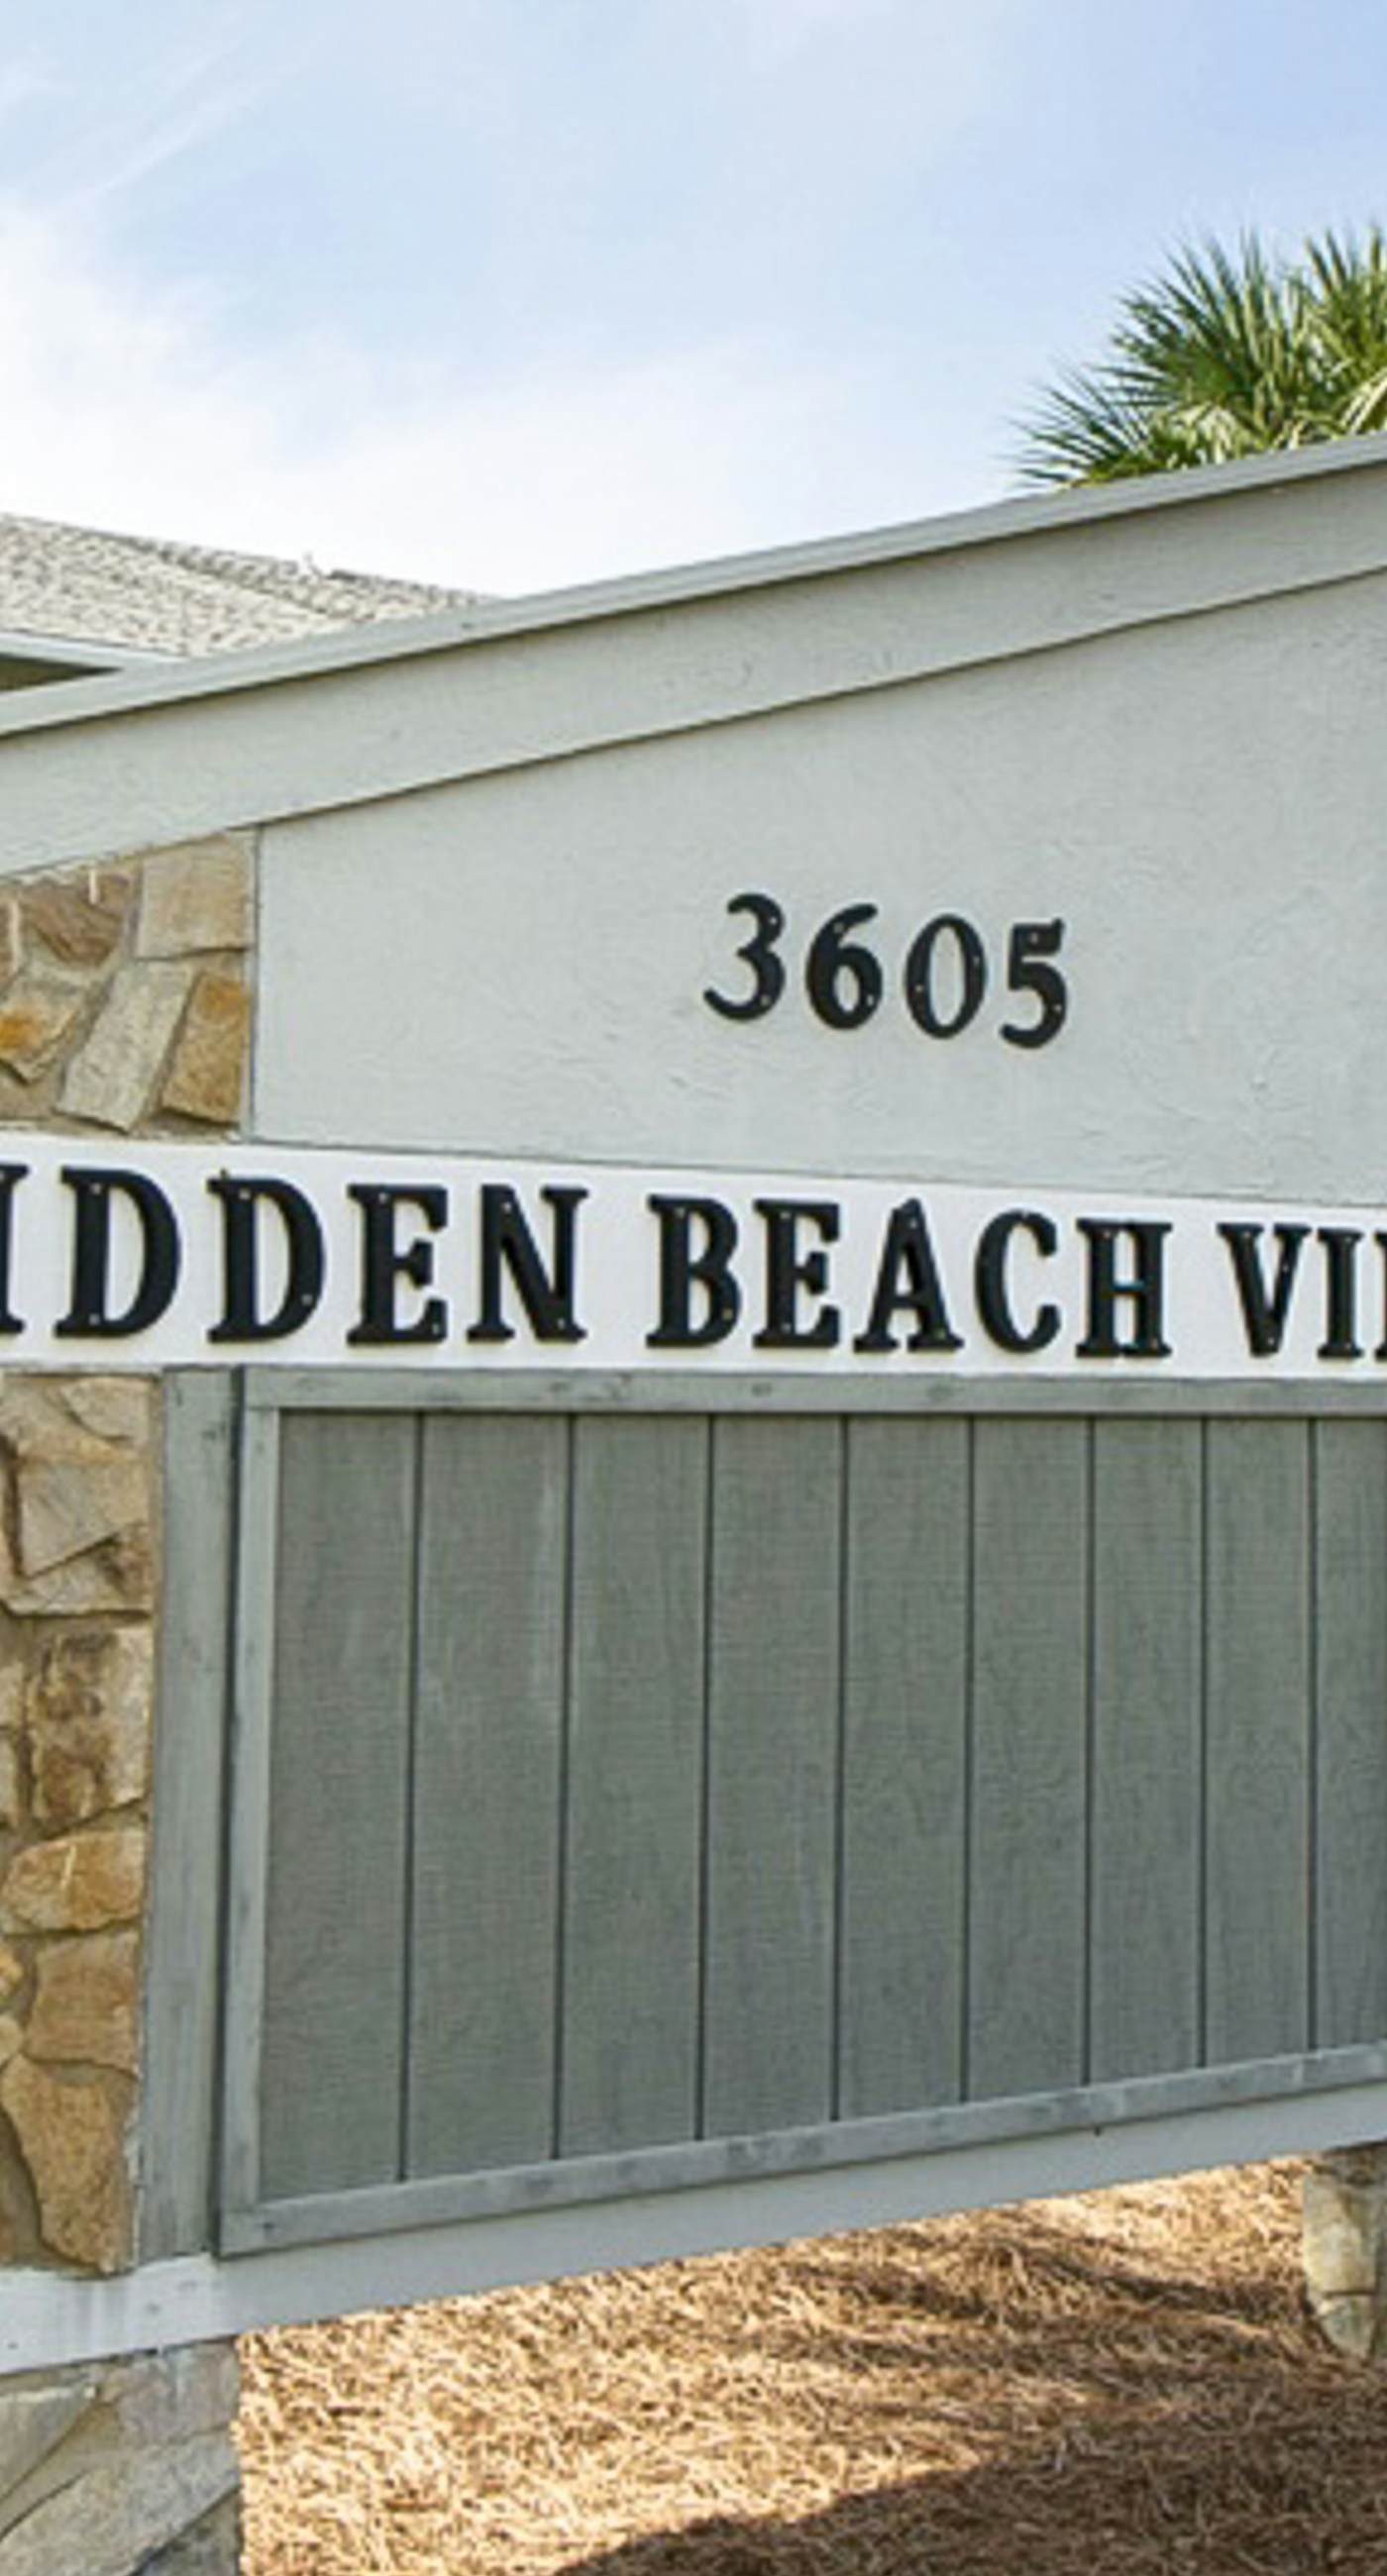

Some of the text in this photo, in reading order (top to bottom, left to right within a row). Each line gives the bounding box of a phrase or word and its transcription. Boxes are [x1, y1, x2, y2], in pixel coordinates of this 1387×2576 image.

[702, 891, 1070, 1051] 3605
[644, 1193, 1174, 1360] BEACH
[1215, 1221, 1387, 1363] VI
